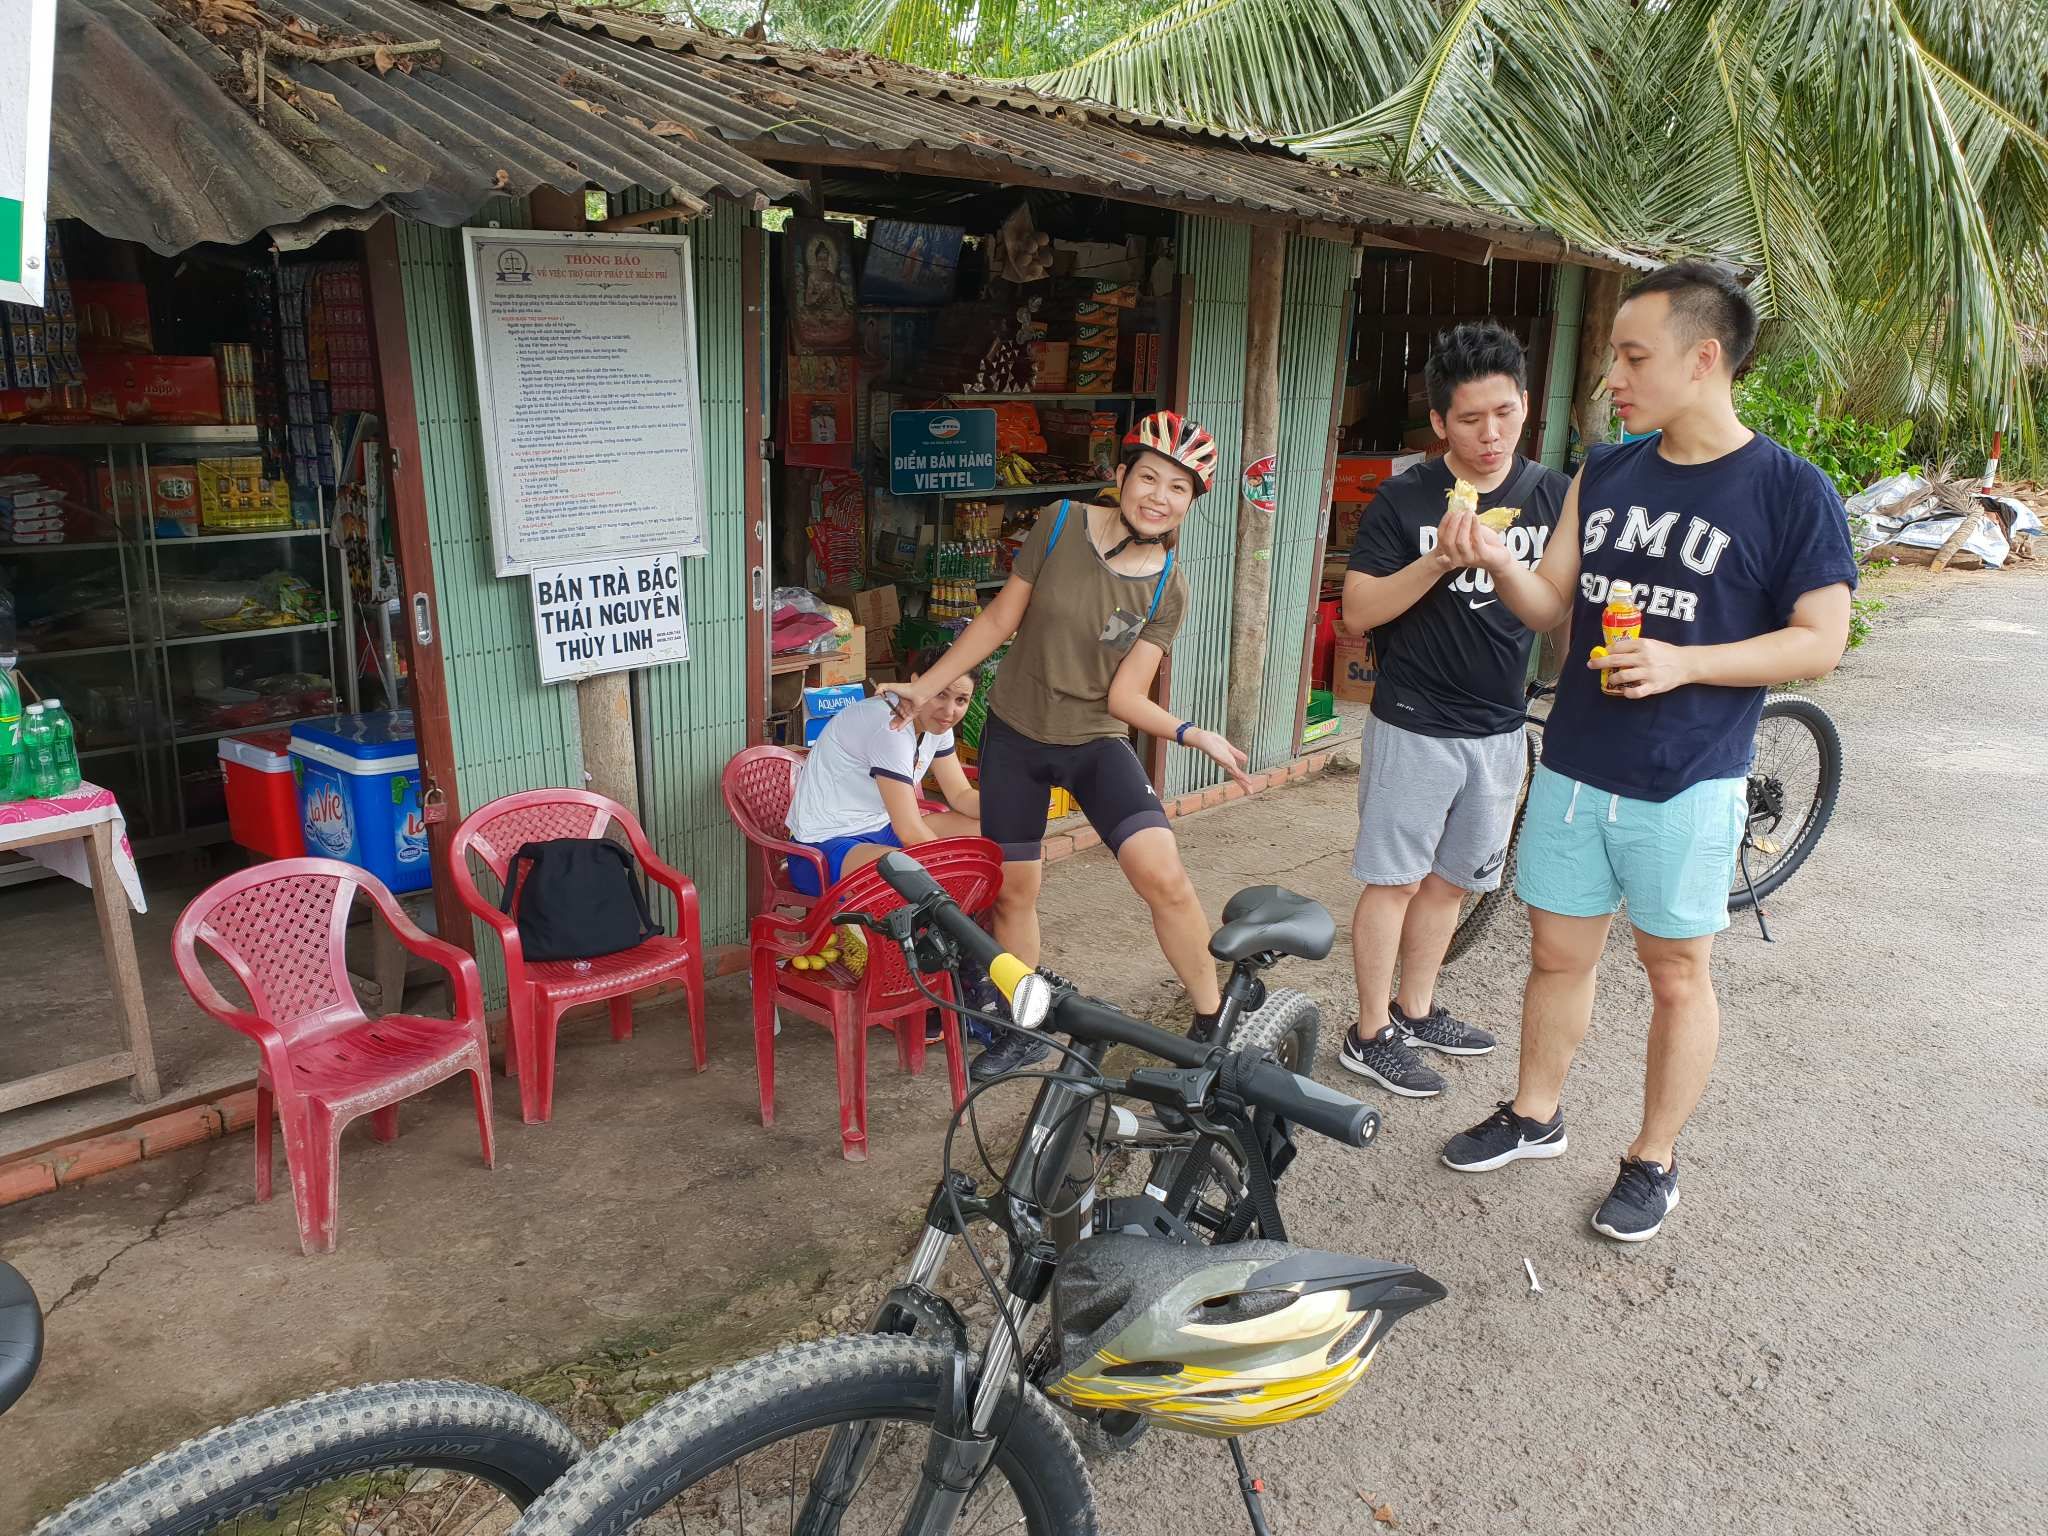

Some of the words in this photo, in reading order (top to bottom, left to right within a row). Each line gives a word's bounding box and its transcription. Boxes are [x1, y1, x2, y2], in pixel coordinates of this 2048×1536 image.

[564, 252, 611, 266] THÔNG
[614, 253, 641, 266] BÁO
[894, 449, 927, 470] ĐIỂM
[929, 451, 956, 469] BÁN
[959, 450, 993, 468] HÀNG
[914, 471, 975, 490] VIETTEL
[1583, 505, 1731, 576] SMU
[538, 573, 583, 606] BÁN
[588, 565, 630, 598] TRÀ
[637, 557, 678, 593] BẮC
[541, 602, 592, 635] THÁI
[599, 591, 681, 627] NGUYÊN
[555, 631, 606, 663] THÙY
[612, 628, 654, 654] LINH
[1347, 661, 1377, 681] Su
[818, 695, 857, 712] AQUAFINA
